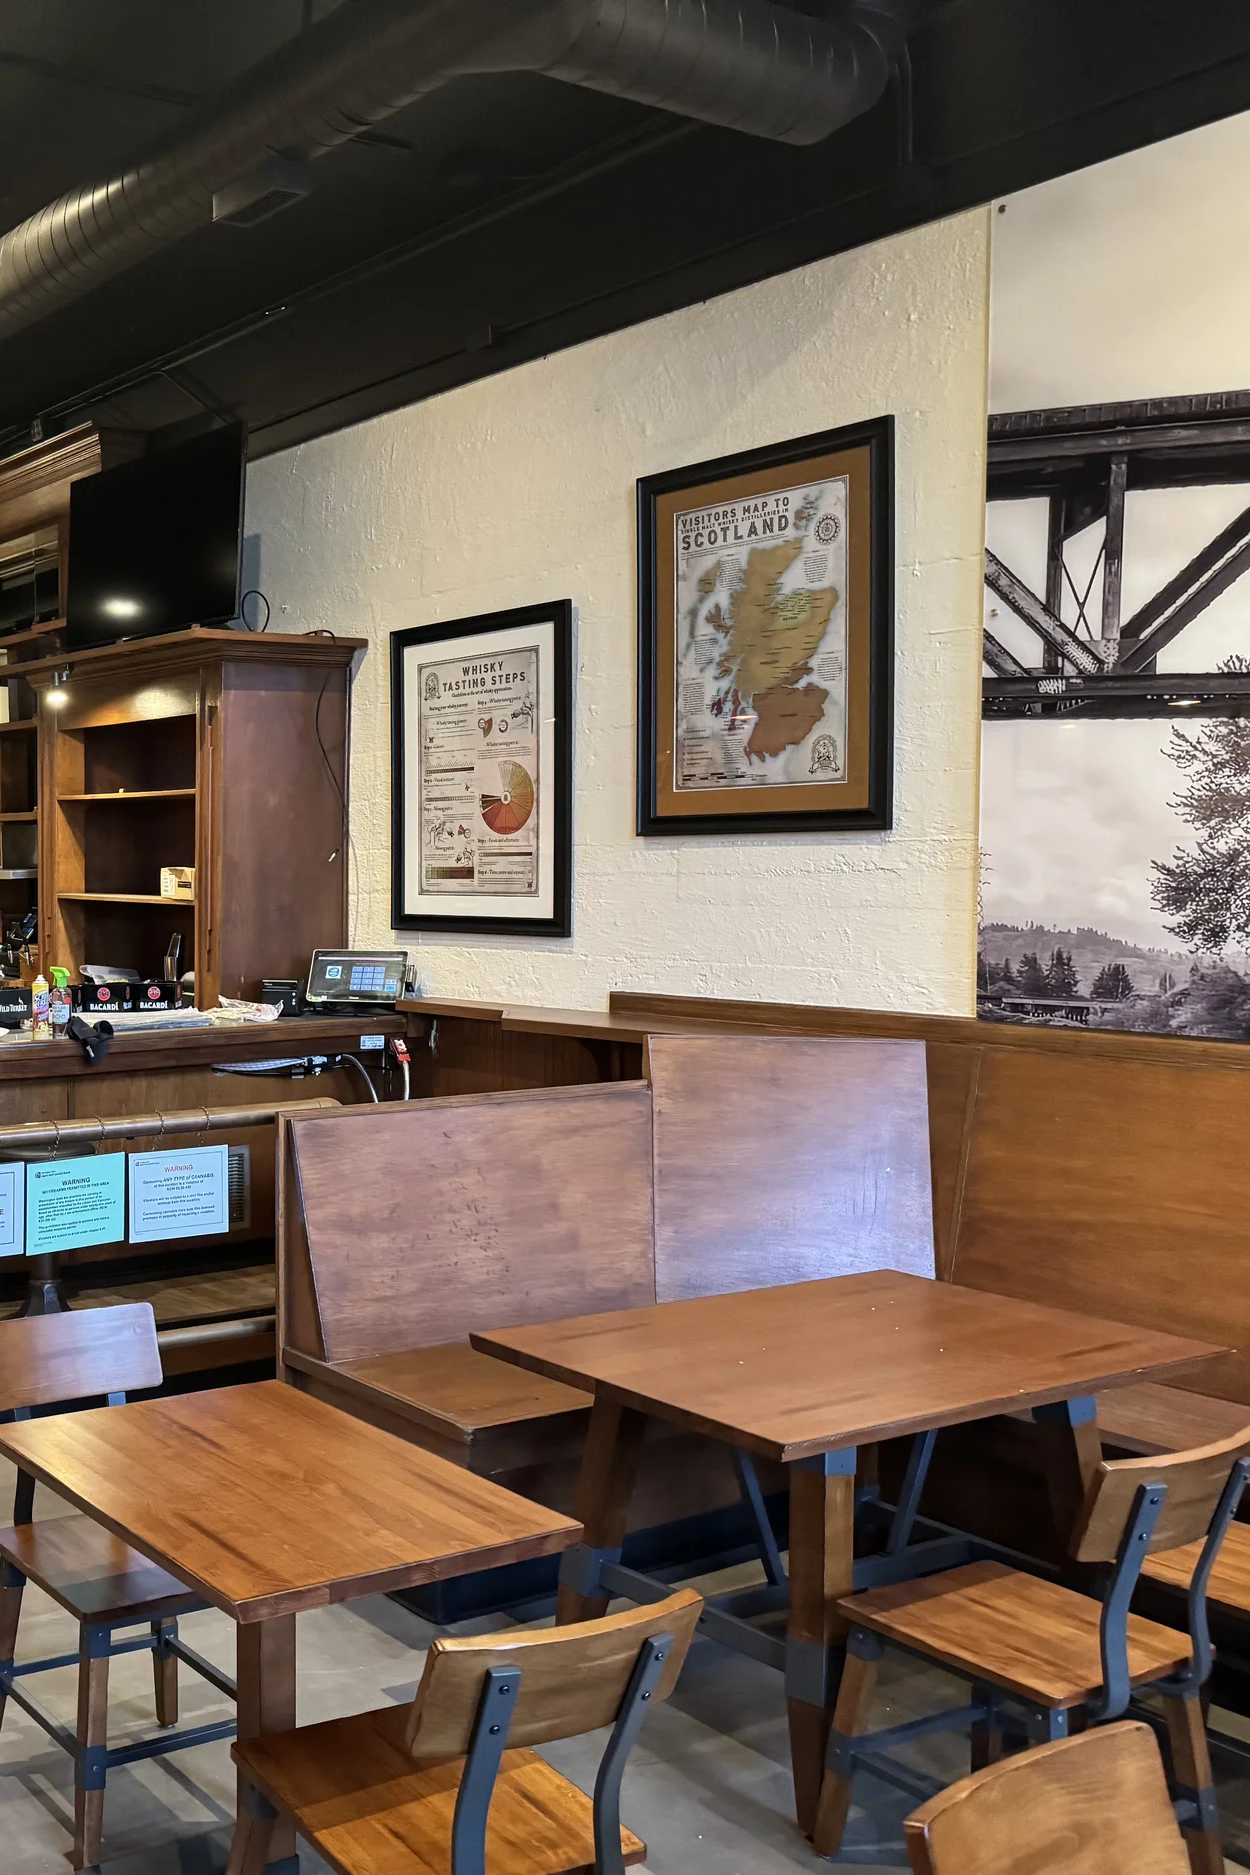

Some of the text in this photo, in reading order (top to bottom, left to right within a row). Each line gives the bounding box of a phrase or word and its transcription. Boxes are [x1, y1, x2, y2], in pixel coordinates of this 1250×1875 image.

[681, 497, 789, 528] VISITORS MAP TO
[741, 510, 780, 522] DISTILLERIES
[682, 515, 789, 550] SCOTLAND
[462, 661, 504, 676] WHISKY
[443, 672, 526, 692] TASTING STEPS
[10, 1004, 28, 1012] TURKEY
[90, 1002, 119, 1010] BACARDÍ
[140, 1000, 168, 1008] BACARDÍ
[62, 1177, 90, 1186] WARNING
